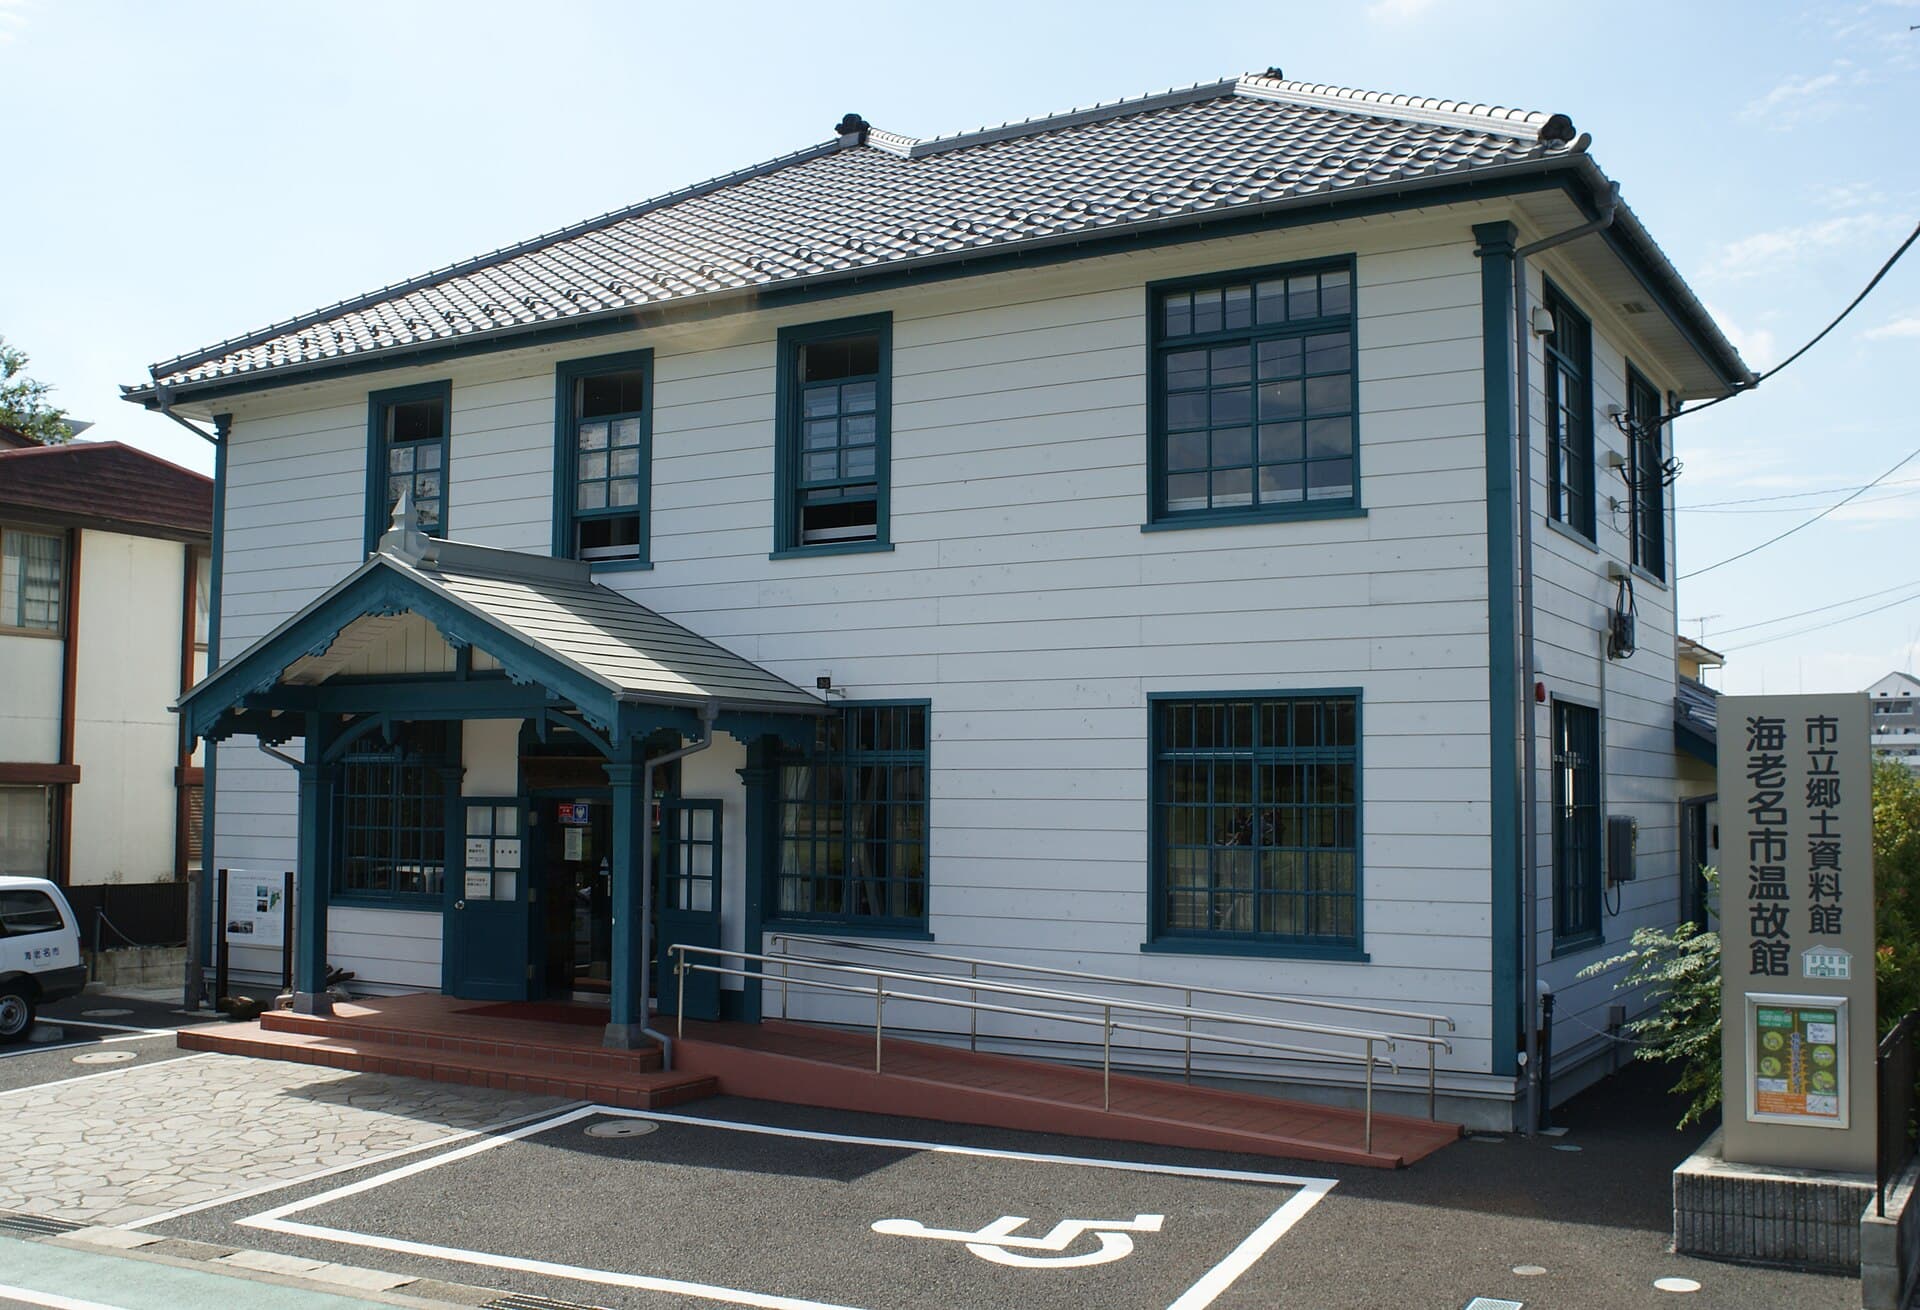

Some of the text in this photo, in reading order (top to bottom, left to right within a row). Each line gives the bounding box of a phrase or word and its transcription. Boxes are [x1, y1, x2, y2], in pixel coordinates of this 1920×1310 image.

[1746, 715, 1791, 977] 海老名市温故館
[1805, 714, 1843, 935] 市立郷土資料館
